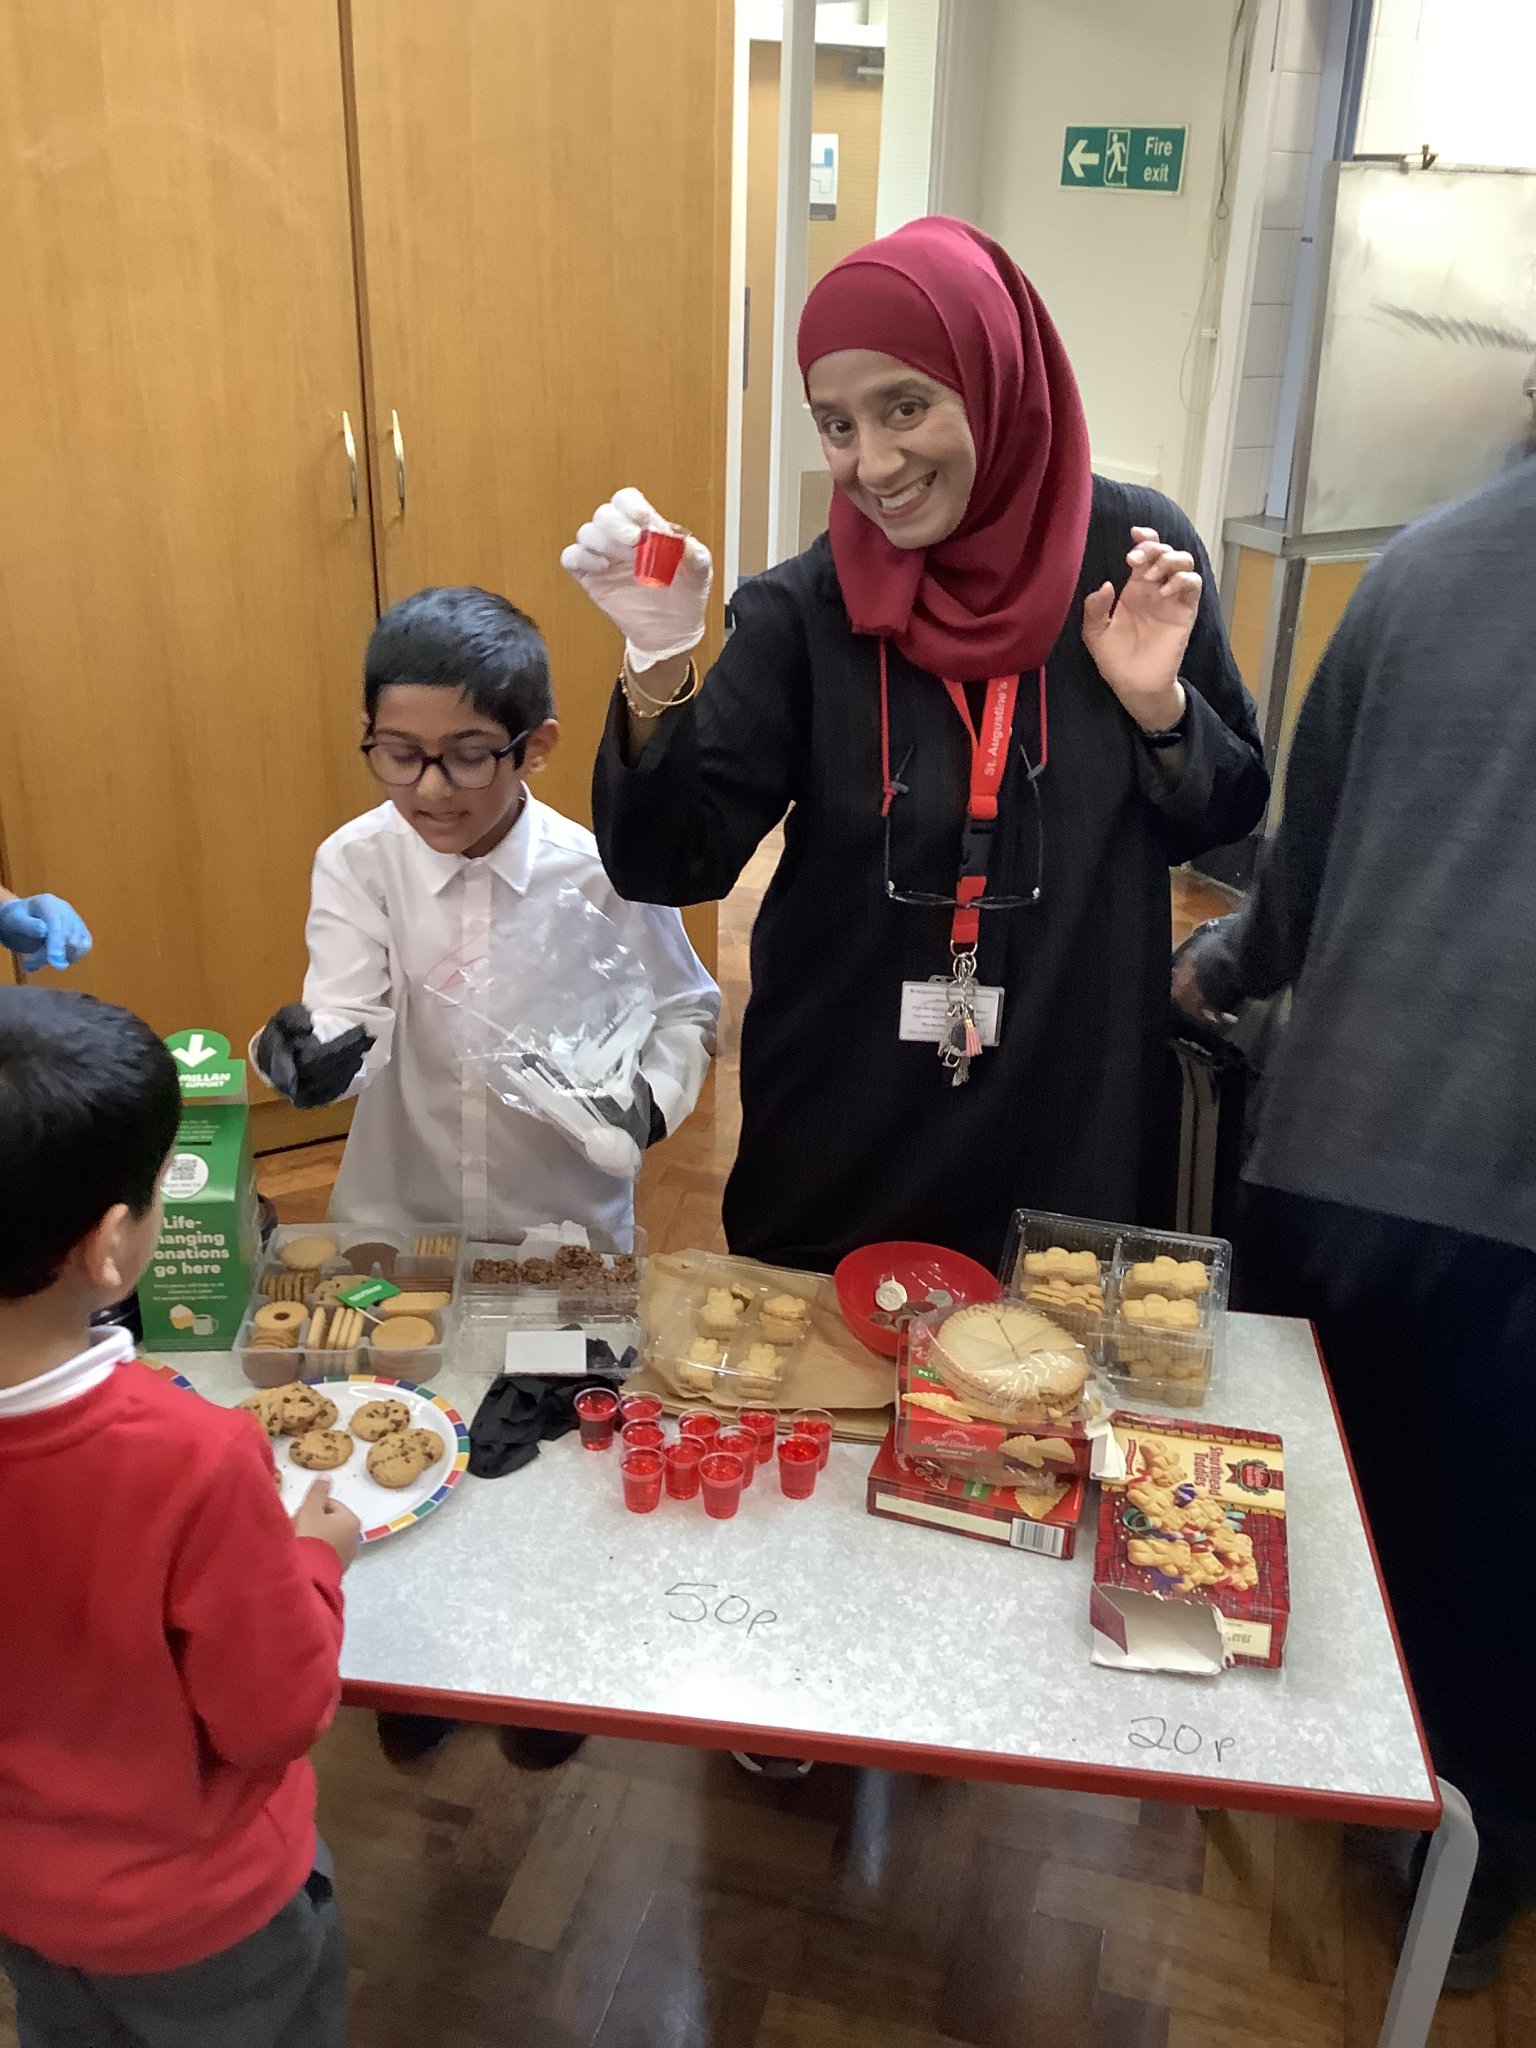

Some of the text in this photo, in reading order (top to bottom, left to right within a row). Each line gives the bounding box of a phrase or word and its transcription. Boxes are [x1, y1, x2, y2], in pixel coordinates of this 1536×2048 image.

[1144, 135, 1174, 157] Fire
[1143, 162, 1170, 183] exit
[983, 681, 1009, 777] St. Augustine's
[178, 1072, 232, 1082] MILLAN
[163, 1215, 202, 1229] Life-
[157, 1231, 225, 1246] hanging
[153, 1245, 230, 1260] onations
[153, 1261, 221, 1278] go here
[1193, 1452, 1209, 1488] Teddies
[1208, 1445, 1224, 1497] Shortbread
[664, 1582, 778, 1638] 50p
[1127, 1716, 1236, 1764] 20p
